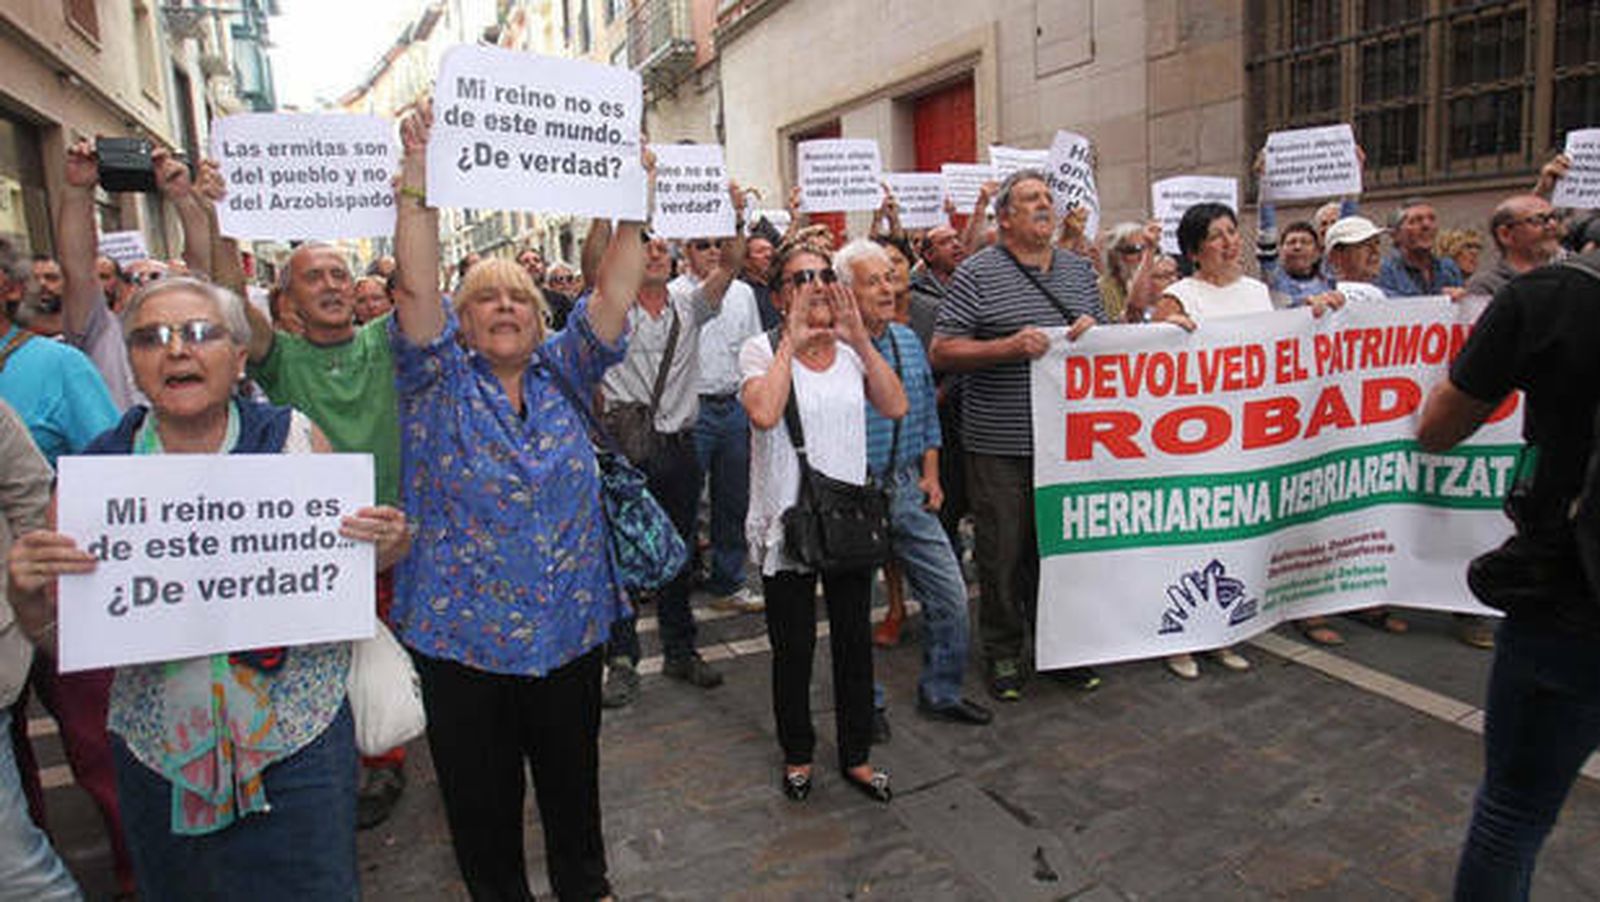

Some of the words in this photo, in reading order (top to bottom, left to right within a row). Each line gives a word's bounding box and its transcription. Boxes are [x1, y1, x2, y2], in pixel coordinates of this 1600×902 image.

[456, 77, 486, 101] Mi
[494, 85, 556, 109] reino
[565, 94, 591, 113] no
[598, 99, 625, 118] es
[444, 106, 476, 128] de
[483, 115, 537, 136] este
[223, 141, 261, 158] Las
[267, 138, 347, 157] ermitas
[353, 142, 388, 157] son
[457, 142, 509, 173] ¿De
[520, 152, 622, 179] verdad?
[230, 167, 264, 185] del
[270, 166, 339, 190] pueblo
[345, 170, 356, 187] y
[360, 168, 387, 182] no
[229, 193, 262, 211] del
[268, 191, 393, 214] Arzobispado
[1065, 343, 1266, 400] DEVOLVED
[1275, 343, 1308, 384] EL
[1314, 323, 1475, 377] PATRIMON
[1065, 376, 1519, 461] ROBAD
[106, 497, 146, 525] Mi
[161, 495, 245, 523] reino
[257, 499, 294, 520] no
[305, 498, 341, 518] es
[1062, 481, 1272, 540] HERRIARENA
[1278, 450, 1515, 520] HERRIARENTZAT
[88, 537, 131, 562] de
[145, 535, 219, 559] este
[107, 576, 184, 617] ¿De
[198, 564, 340, 602] verdad?
